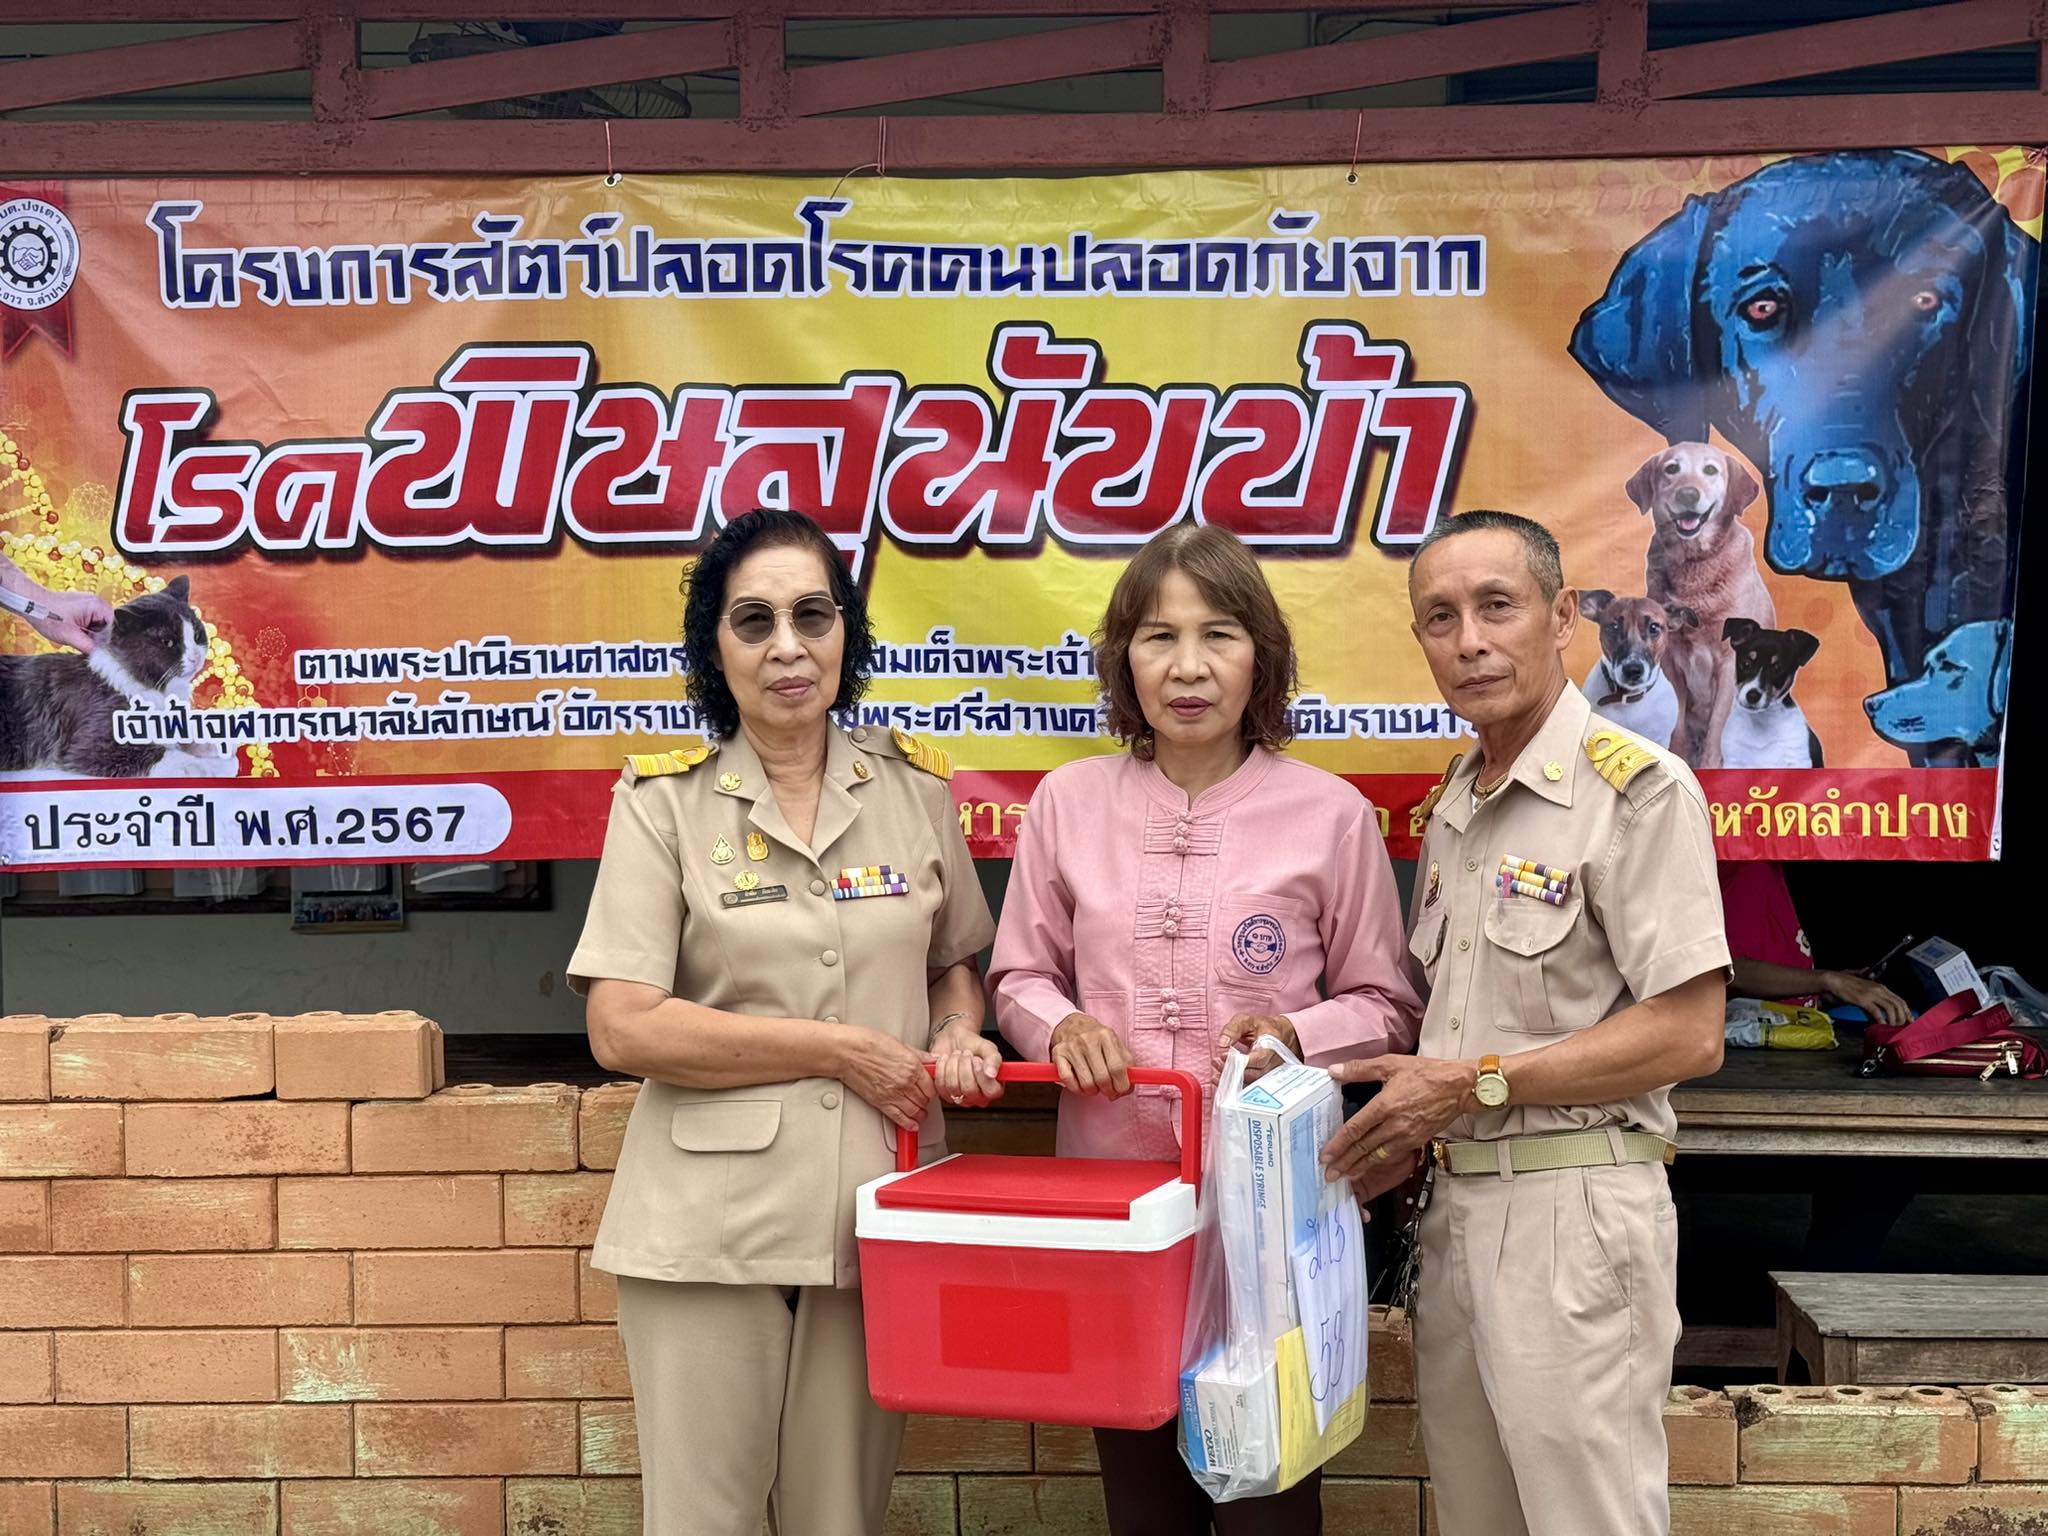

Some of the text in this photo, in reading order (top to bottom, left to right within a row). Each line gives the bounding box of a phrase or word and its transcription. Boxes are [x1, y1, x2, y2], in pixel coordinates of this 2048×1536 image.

[24, 793, 466, 851] ประจำปี พ.ศ.2567
[1252, 1119, 1264, 1171] DISPOSABLE
[1266, 1123, 1274, 1167] TERUMO
[1310, 1311, 1345, 1401] 53
[1204, 1429, 1217, 1467] WEGO
